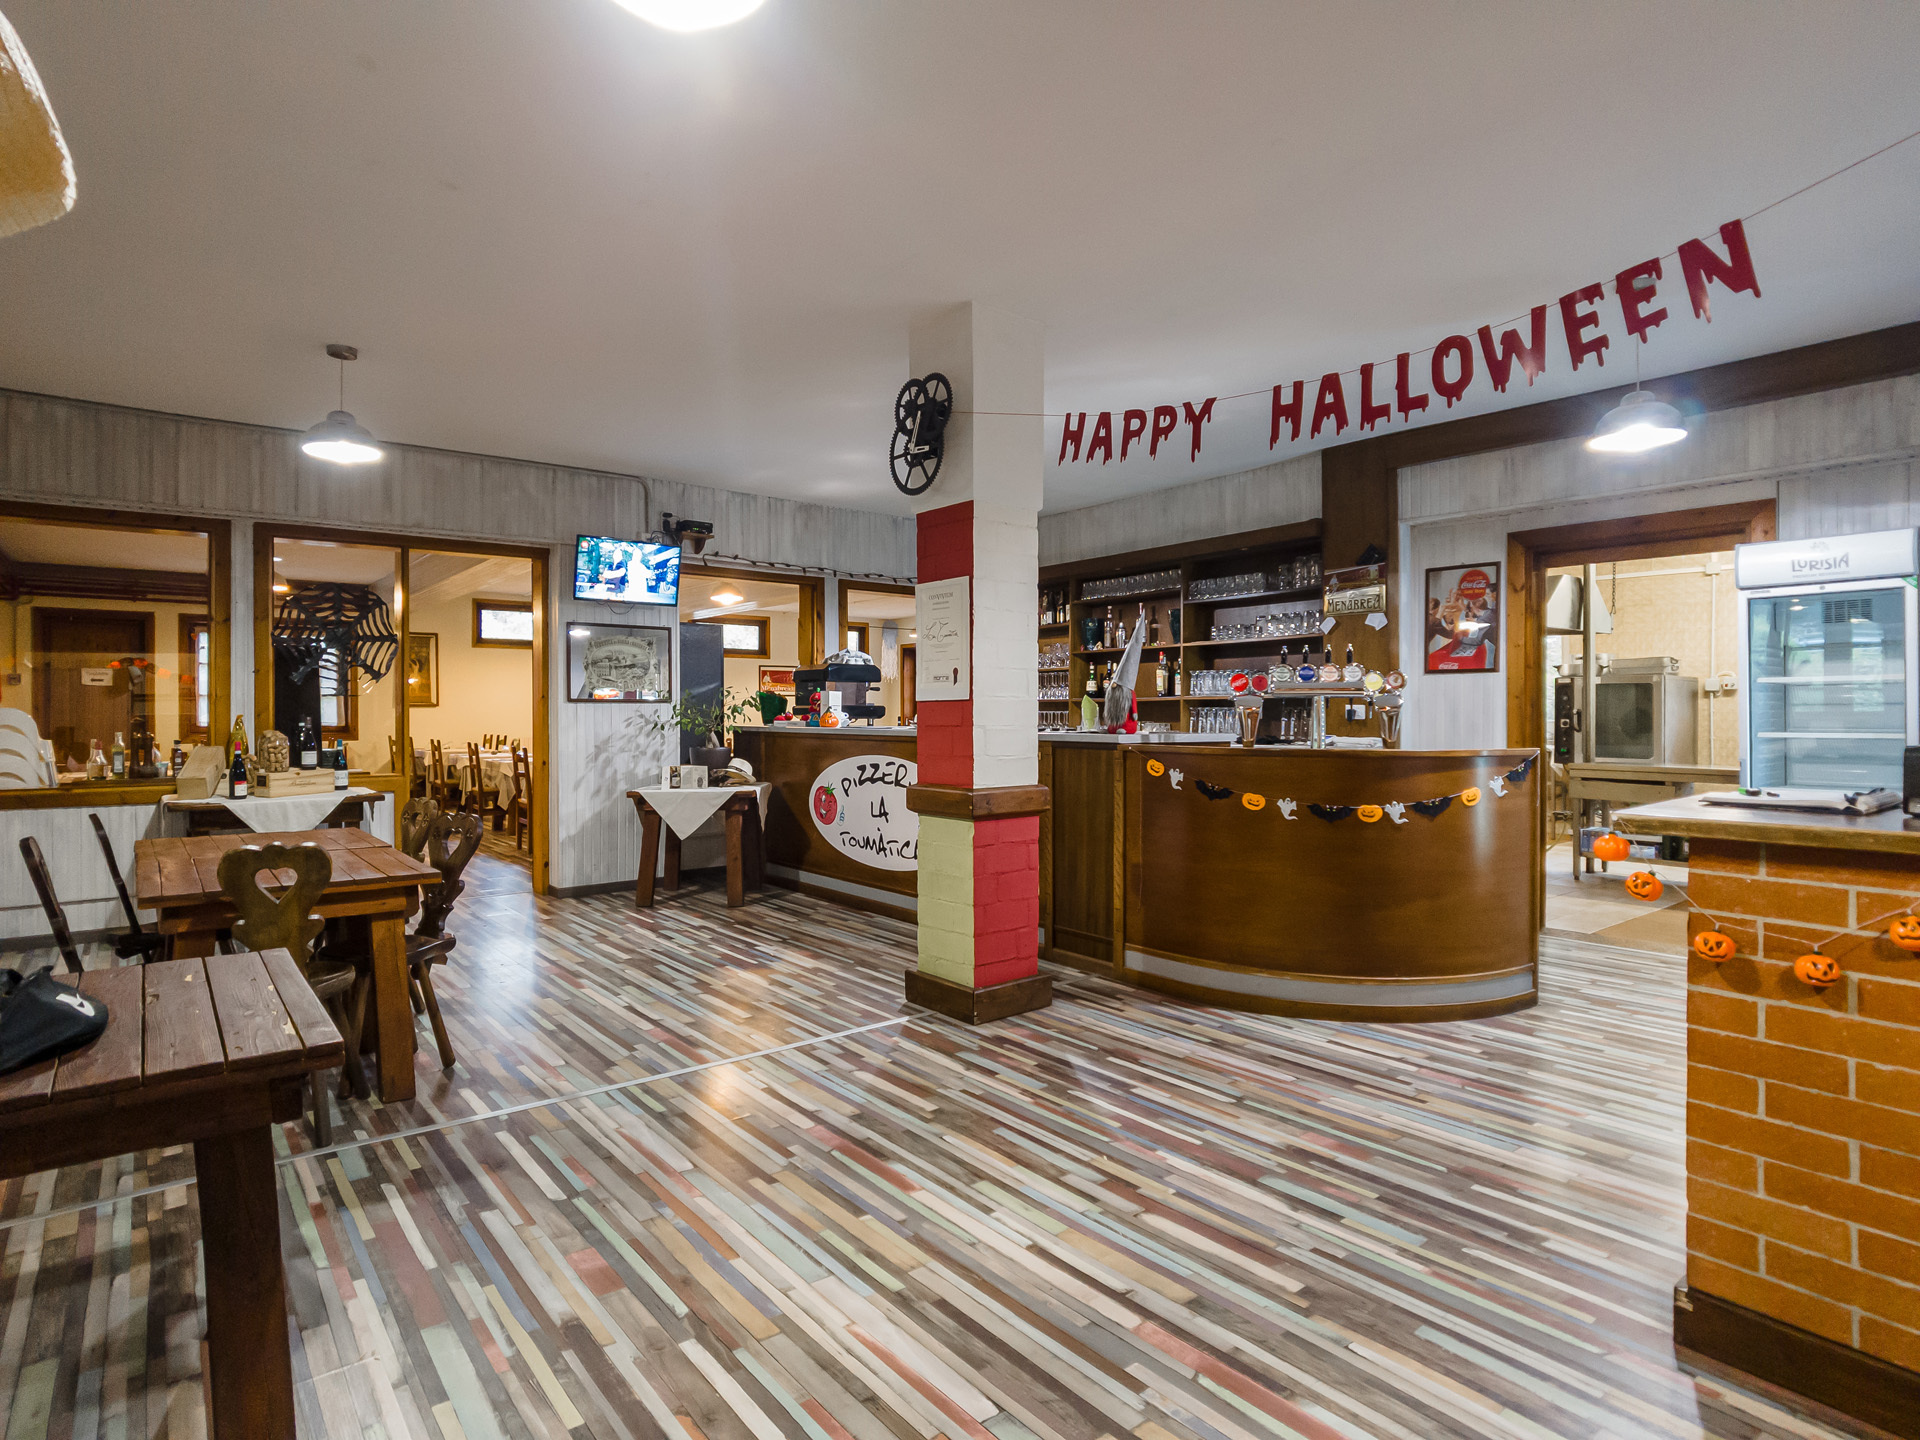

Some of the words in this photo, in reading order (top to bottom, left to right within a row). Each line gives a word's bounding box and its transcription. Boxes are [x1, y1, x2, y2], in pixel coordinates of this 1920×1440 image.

[1058, 397, 1217, 466] HAPPY
[1270, 219, 1761, 450] HALLOWEEN
[1791, 552, 1849, 572] LURISIA
[841, 761, 912, 798] PIZZER
[870, 795, 889, 823] LA
